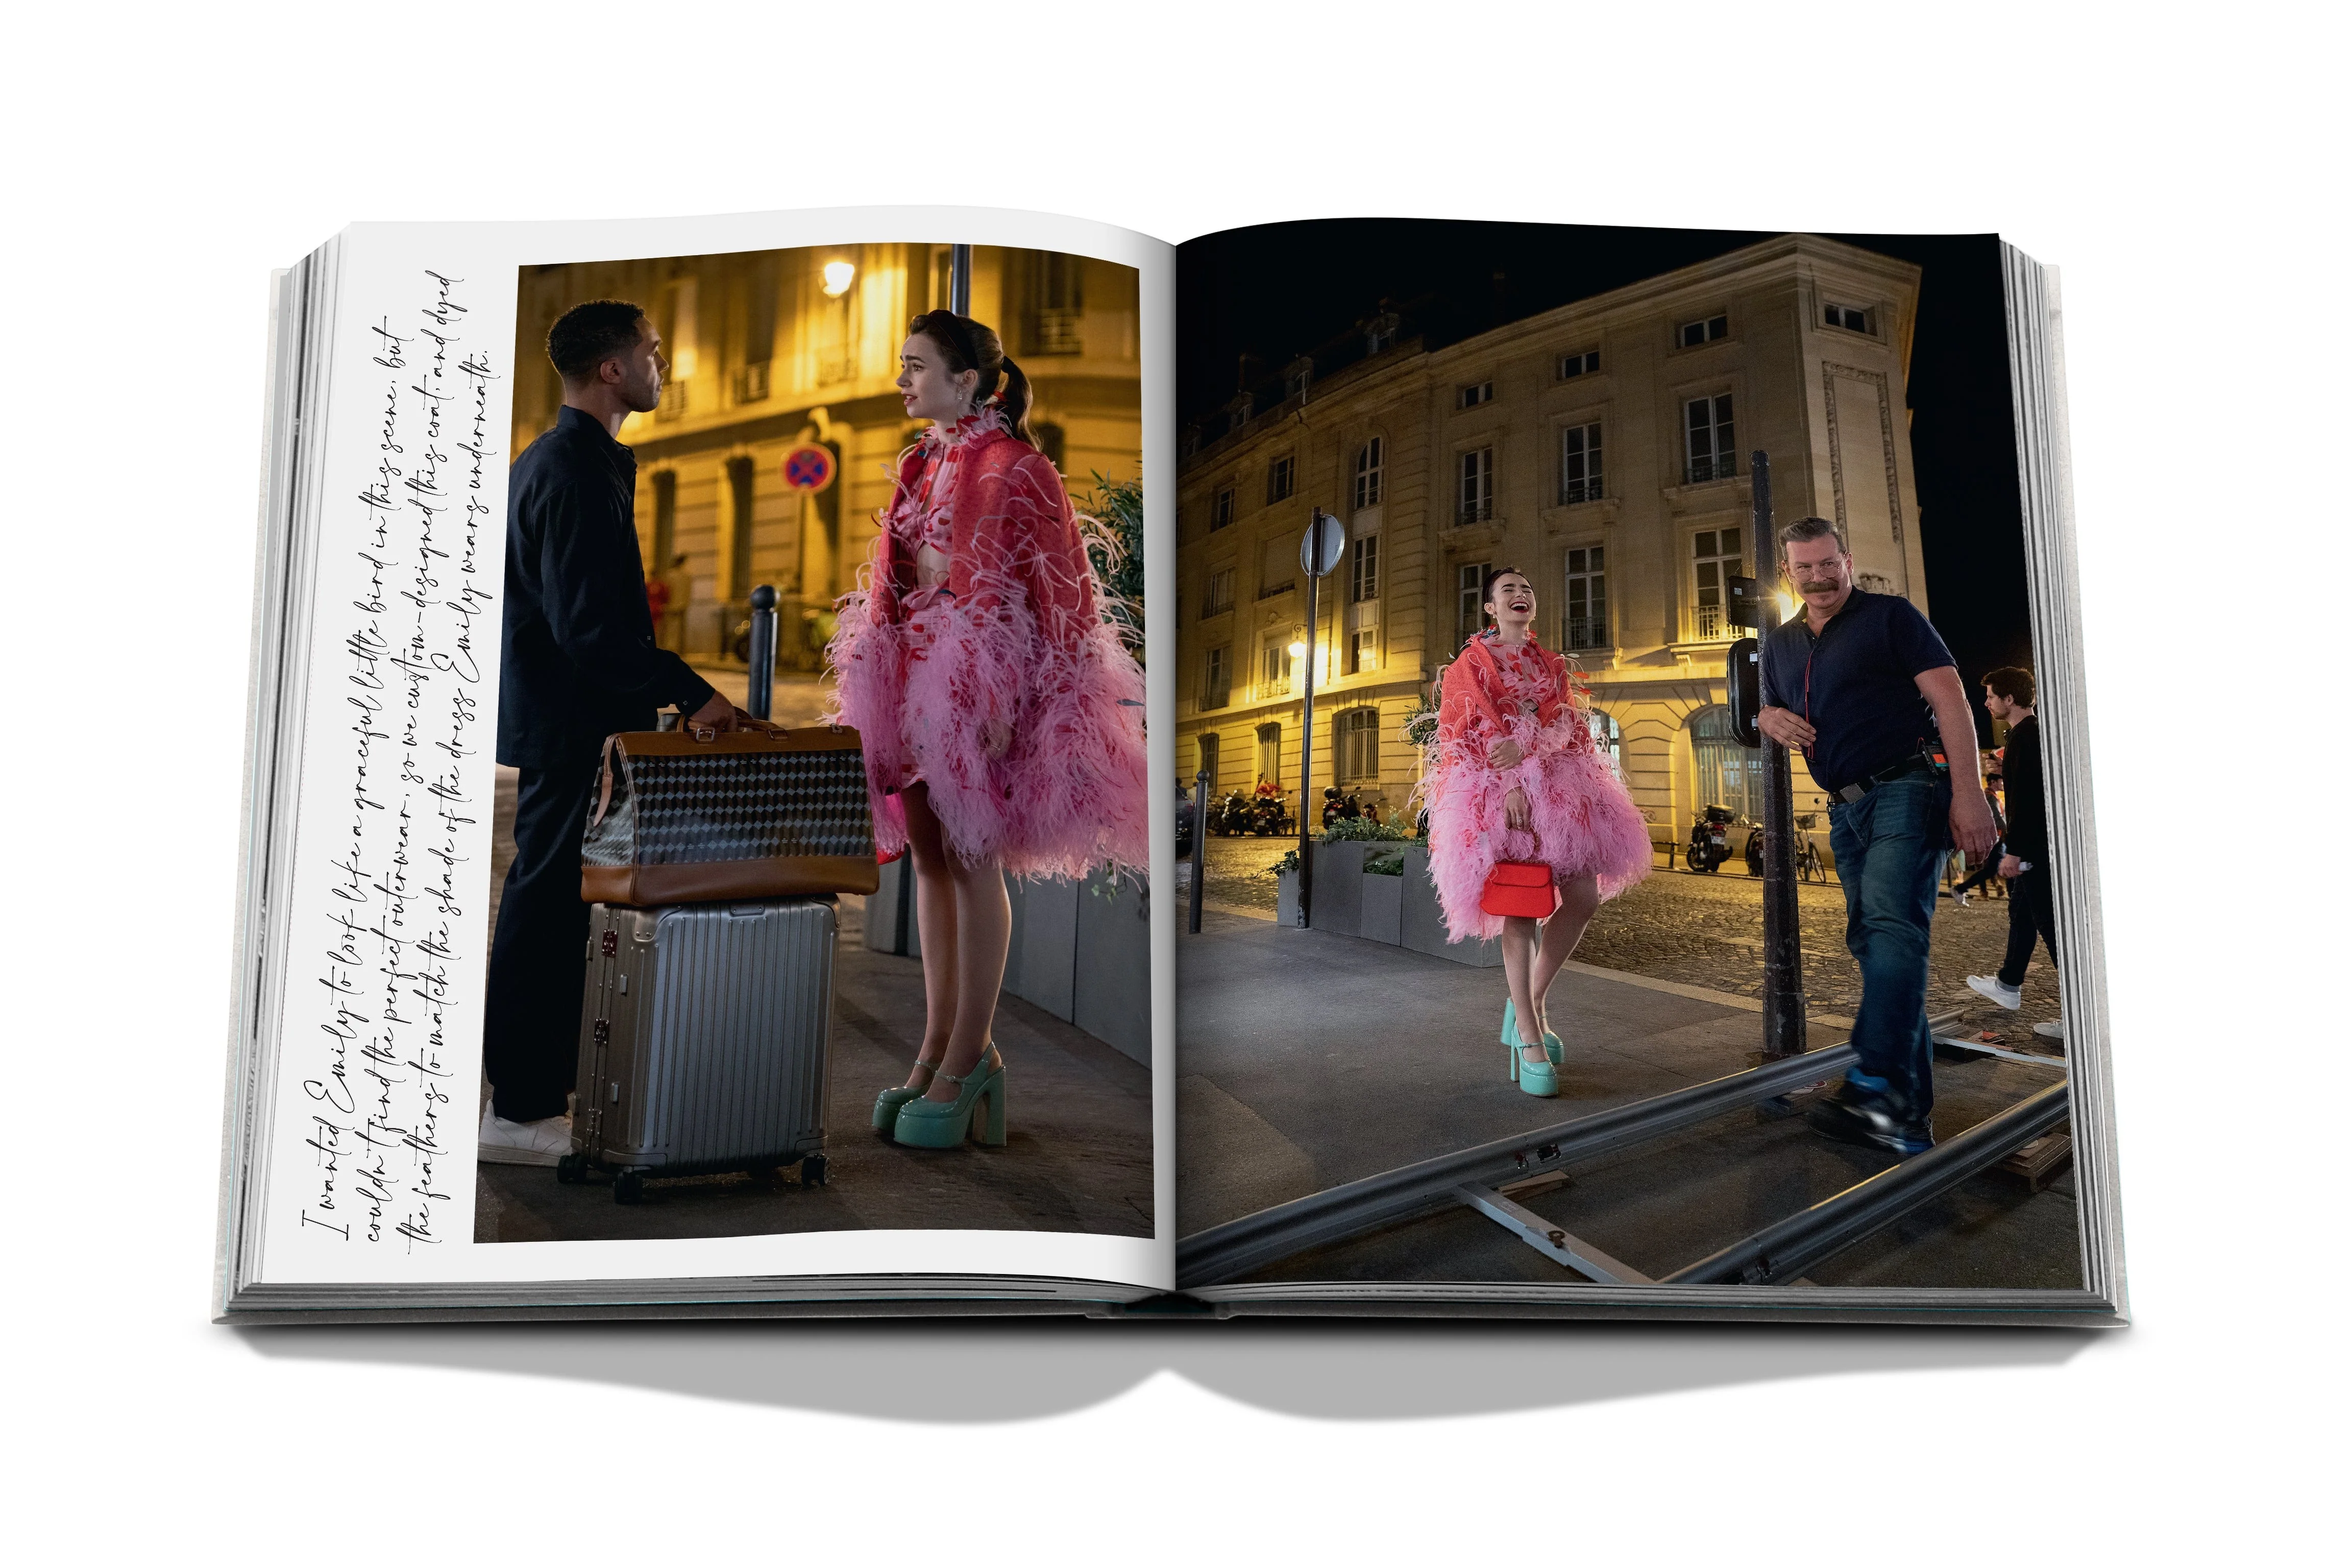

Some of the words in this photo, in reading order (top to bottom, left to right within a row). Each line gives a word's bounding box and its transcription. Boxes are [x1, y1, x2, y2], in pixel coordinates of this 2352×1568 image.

[422, 270, 468, 325] dyed
[372, 315, 414, 368] but
[421, 329, 460, 377] and
[381, 381, 403, 453] scene,
[411, 374, 454, 437] coat,
[457, 351, 501, 488] underneath.
[358, 458, 401, 520] this
[404, 445, 447, 506] this
[371, 516, 387, 548] in
[461, 496, 489, 573] wears
[353, 552, 398, 612] bird
[390, 498, 449, 708] custom-designed
[346, 620, 390, 689] little
[430, 580, 493, 682] Emily
[347, 695, 389, 810] graceful
[402, 715, 417, 746] we
[435, 688, 476, 758] dress
[401, 753, 424, 783] so
[427, 766, 472, 813] the
[353, 815, 361, 836] a
[438, 808, 476, 832] of
[331, 843, 371, 902] like
[374, 794, 418, 926] outerwear,
[424, 839, 469, 916] shade
[327, 909, 367, 965] look
[416, 921, 461, 971] the
[318, 966, 364, 1005] to
[370, 915, 418, 1024] perfect
[412, 966, 458, 1046] match
[304, 1001, 369, 1113] Emily
[361, 1027, 406, 1076] the
[407, 1048, 453, 1088] to
[364, 1069, 407, 1134] find
[306, 1116, 355, 1209] wanted
[402, 1083, 451, 1199] feathers
[302, 1209, 349, 1241] I
[396, 1203, 442, 1255] the
